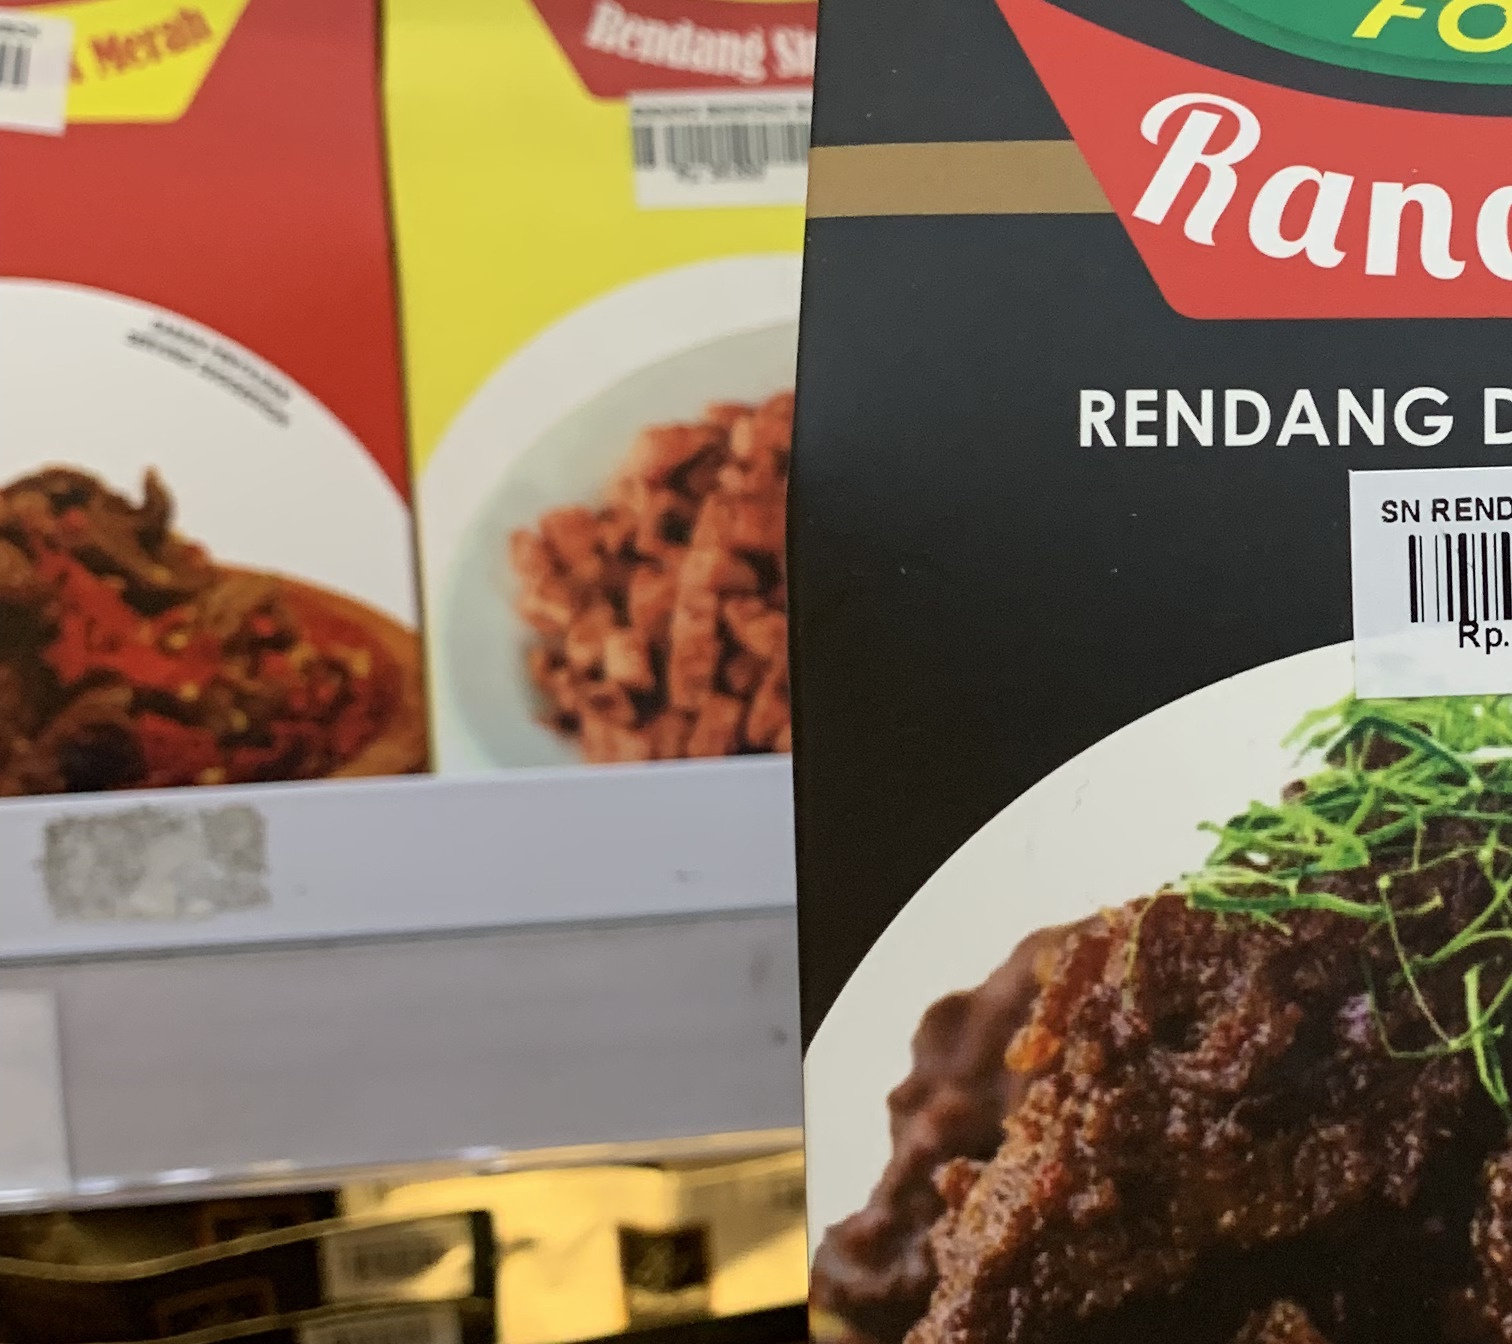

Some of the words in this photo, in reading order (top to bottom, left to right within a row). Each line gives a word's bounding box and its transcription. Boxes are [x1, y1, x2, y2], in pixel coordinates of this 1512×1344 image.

[1079, 387, 1454, 449] RENDANG
[1381, 499, 1421, 523] SN
[1459, 621, 1510, 654] Rp.
